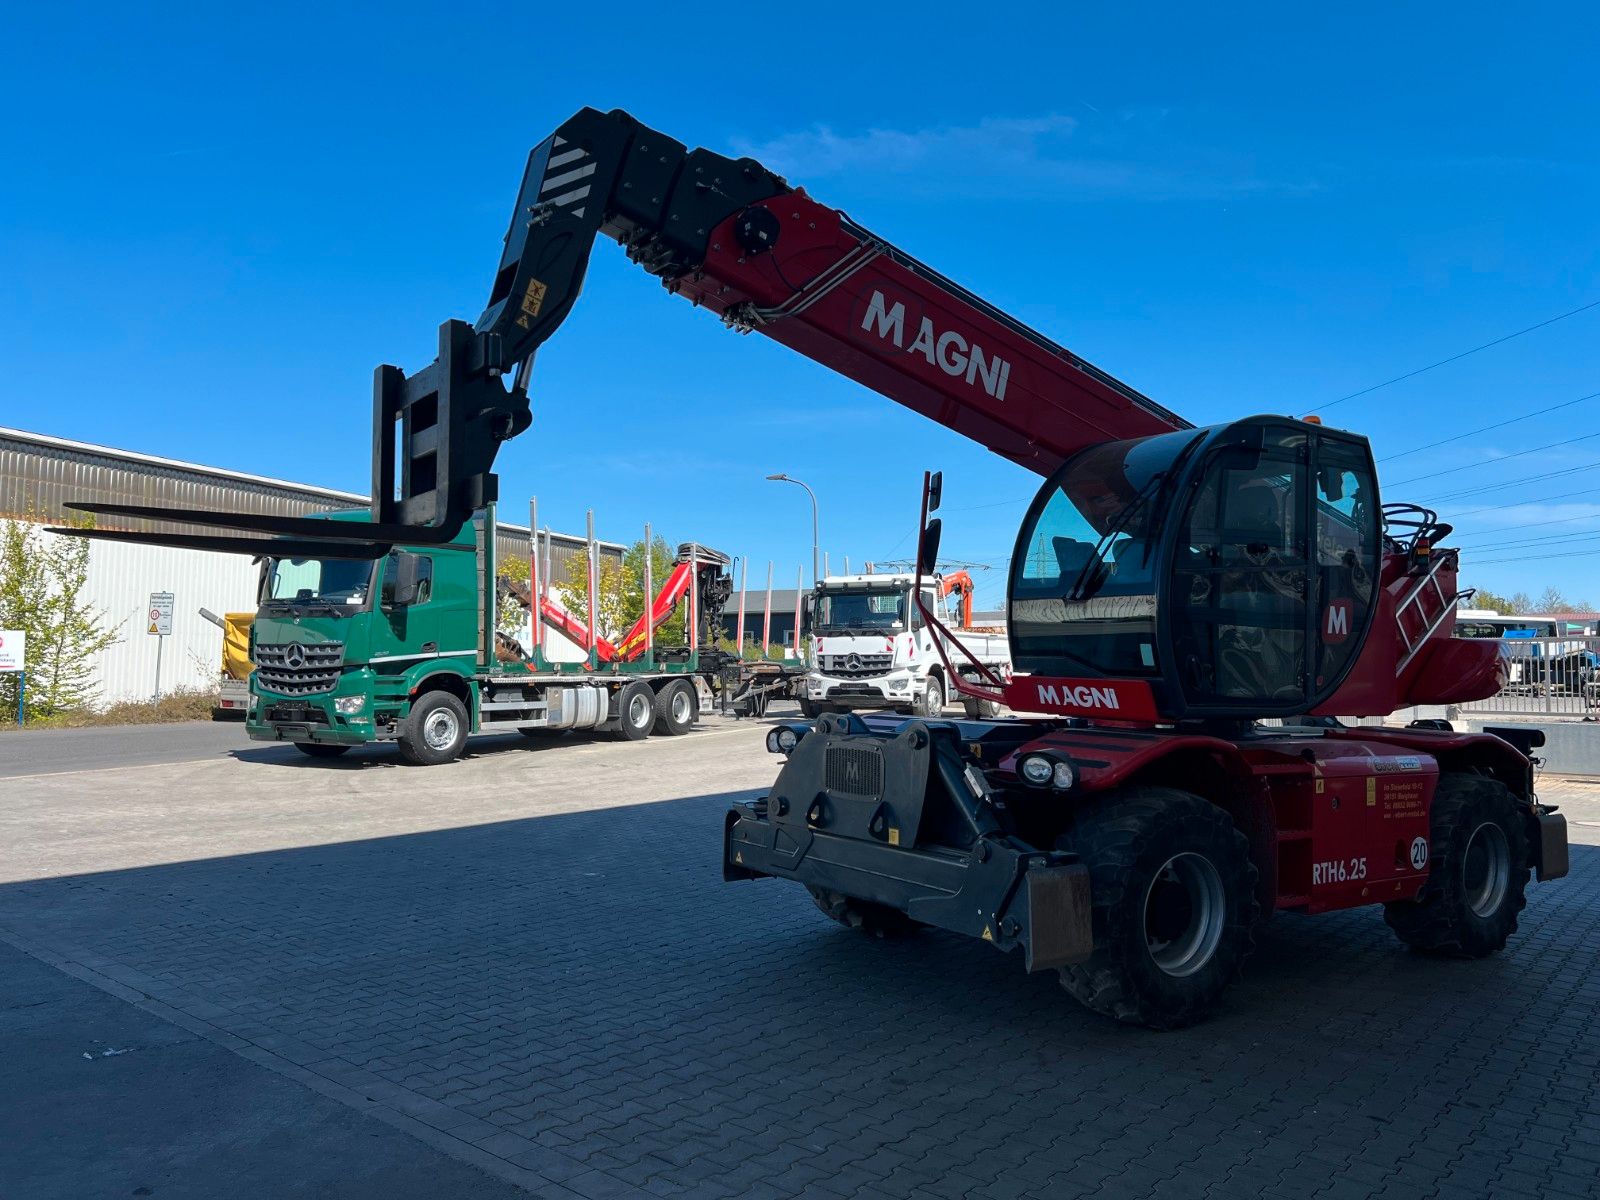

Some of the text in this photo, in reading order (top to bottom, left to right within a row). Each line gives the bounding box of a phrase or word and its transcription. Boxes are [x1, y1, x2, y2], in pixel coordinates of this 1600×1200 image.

[861, 289, 1011, 402] MAGNI
[1327, 605, 1347, 635] M
[1037, 684, 1120, 710] MAGNI
[1412, 842, 1427, 865] 20
[1312, 857, 1367, 886] RTH6.25
